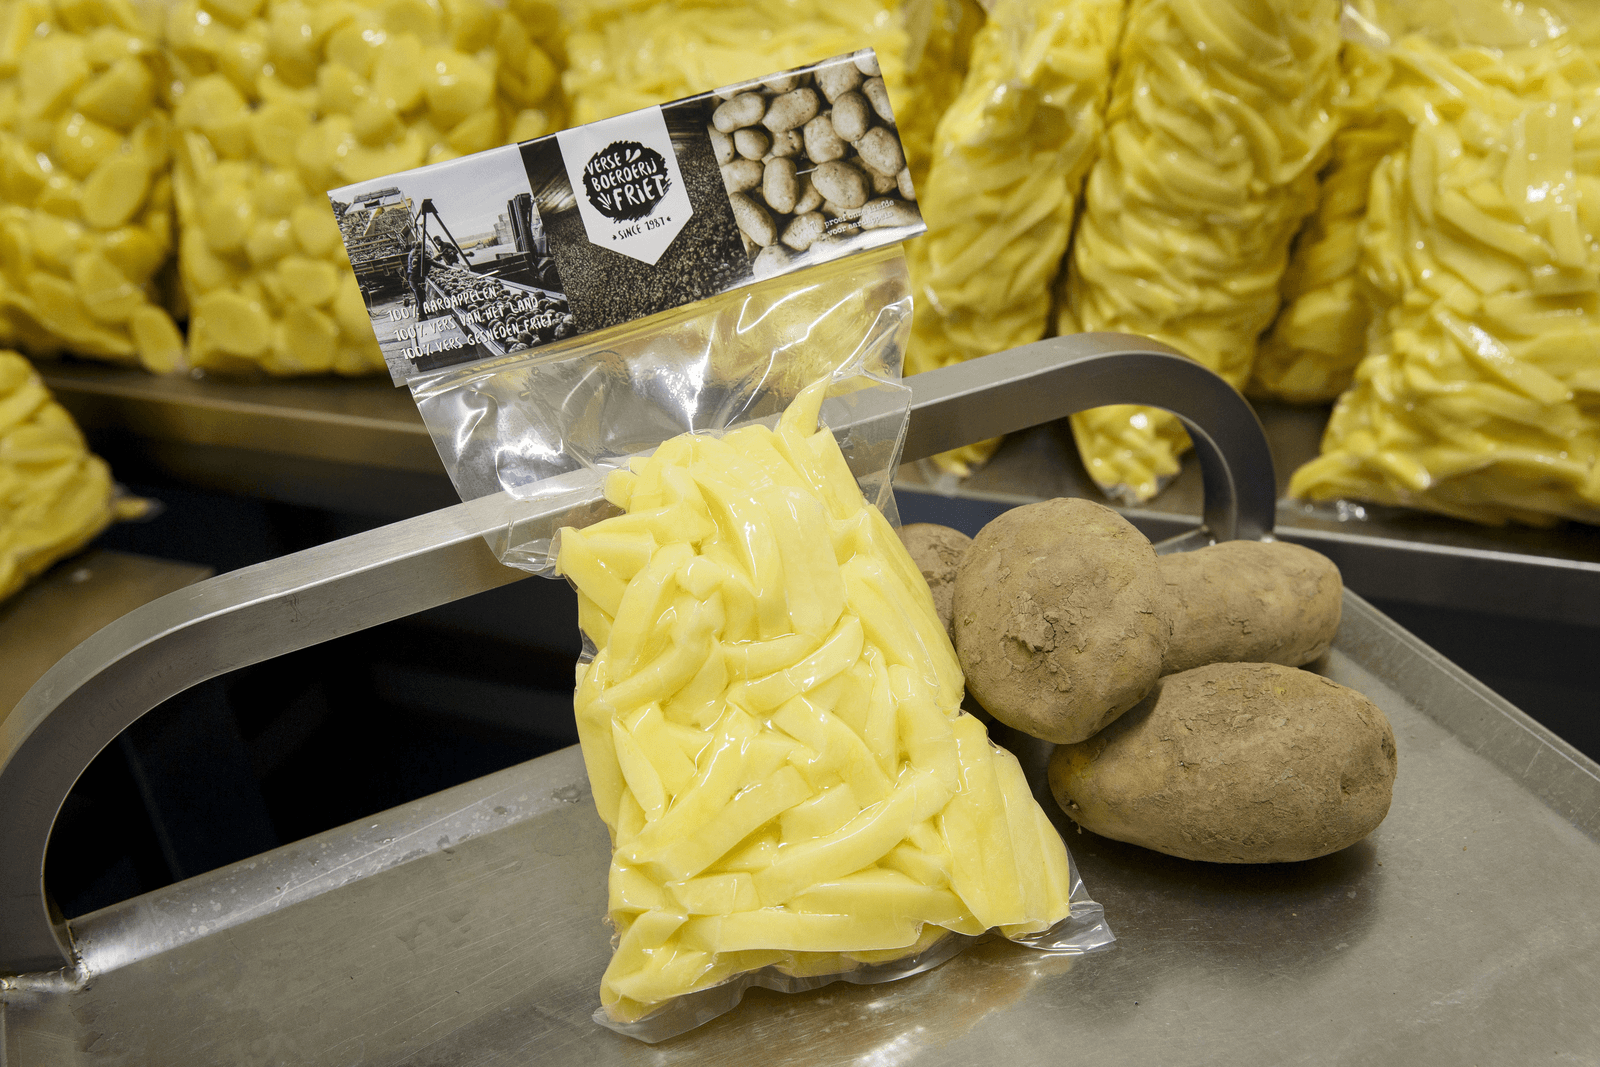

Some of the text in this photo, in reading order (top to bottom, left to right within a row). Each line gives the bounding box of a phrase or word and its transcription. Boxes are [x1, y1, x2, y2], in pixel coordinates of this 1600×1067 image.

[586, 152, 622, 175] VERSE
[591, 157, 658, 192] BOERDERIJ
[612, 174, 664, 211] FRIET
[618, 217, 665, 240] SINCE 1987
[824, 212, 847, 229] proef
[827, 226, 847, 236] voor
[387, 287, 498, 322] 100% AARDAPPELEN
[394, 297, 539, 342] 100% VERS VAN HET LAND
[401, 313, 553, 361] 100% VERS GESNEDEN FRIET
